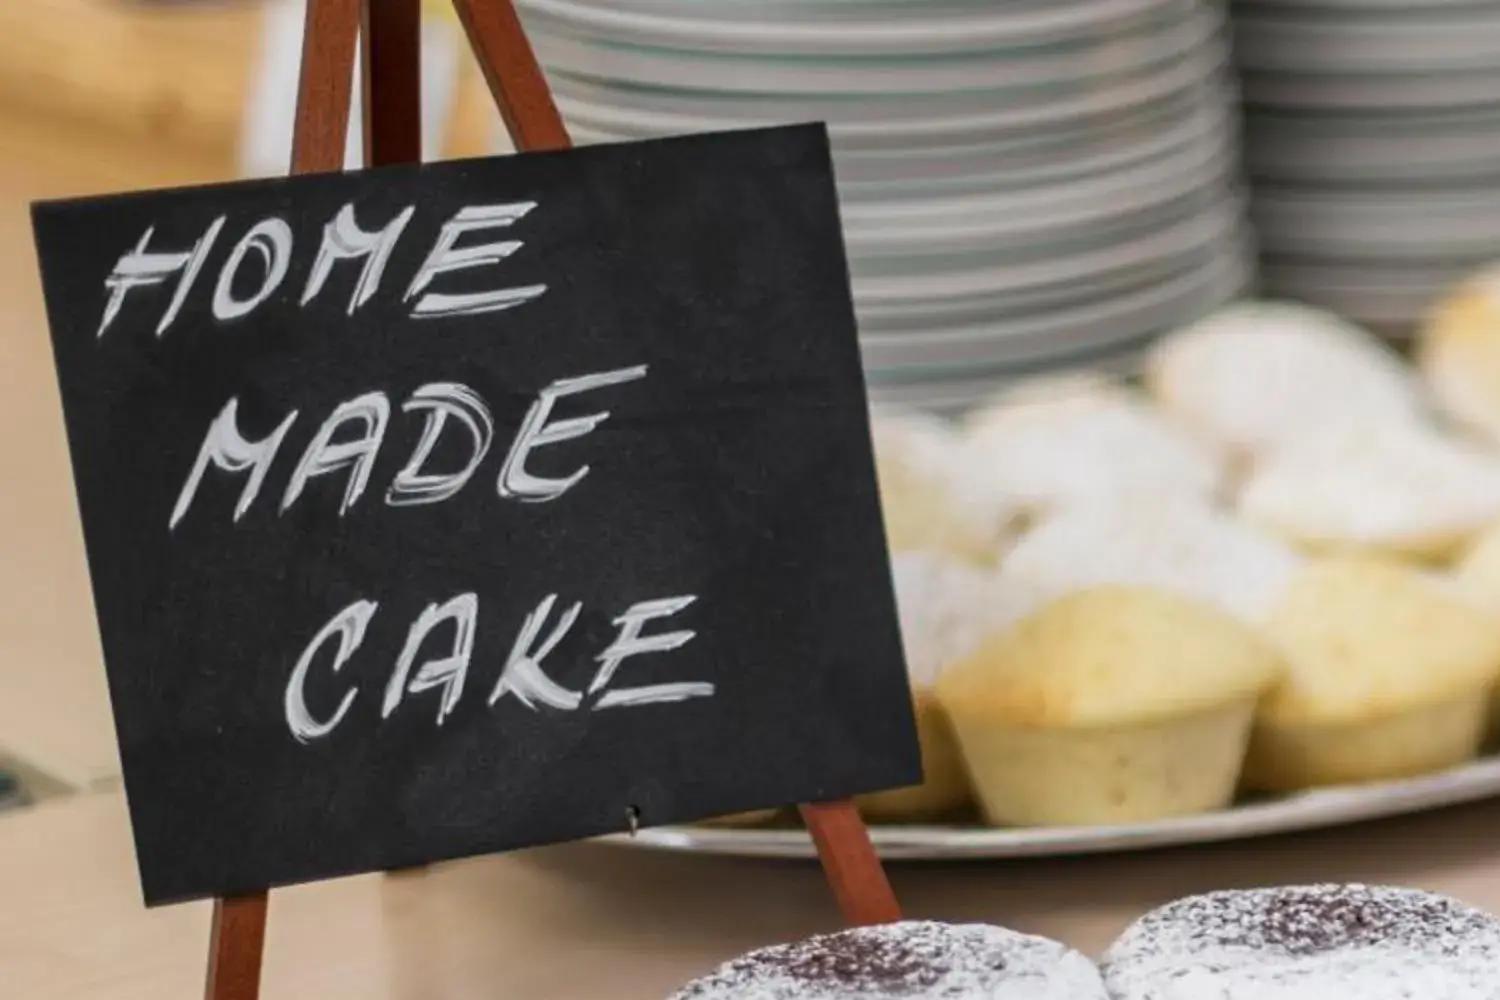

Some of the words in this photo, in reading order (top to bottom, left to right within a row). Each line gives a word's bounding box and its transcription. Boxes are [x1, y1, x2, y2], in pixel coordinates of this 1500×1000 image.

[98, 202, 547, 337] HOME
[170, 365, 648, 529] MADE
[285, 593, 715, 743] CAKE
